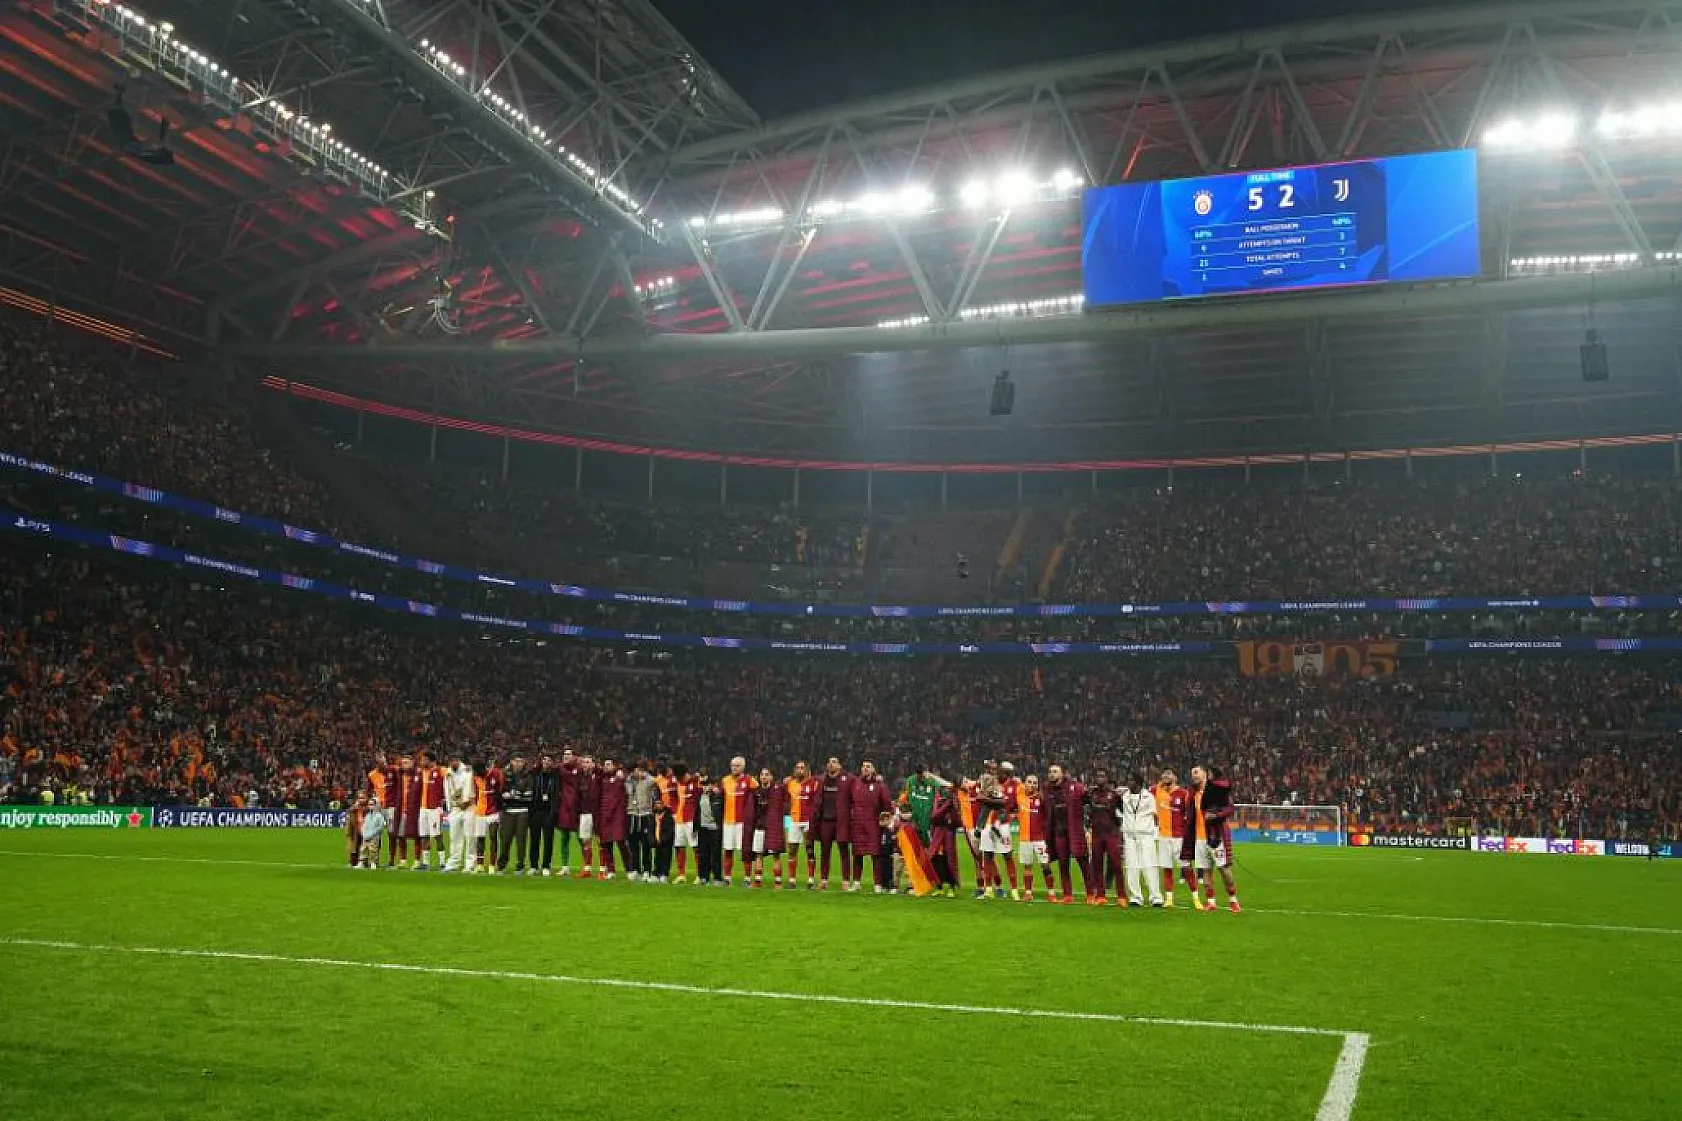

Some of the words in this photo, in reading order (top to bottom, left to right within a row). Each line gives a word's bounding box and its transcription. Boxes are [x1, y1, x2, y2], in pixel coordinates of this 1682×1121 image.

[1248, 187, 1263, 210] 5
[1279, 184, 1294, 208] 2
[65, 470, 94, 485] LEAGUE
[38, 809, 122, 828] responsibly
[179, 811, 214, 827] UEFA
[217, 811, 288, 828] CHAMPIONS
[291, 813, 333, 828] LEAGUE
[1275, 831, 1317, 843] PS5
[1373, 834, 1466, 849] mastercard
[1477, 836, 1528, 853] FedEx
[1546, 838, 1598, 854] FedEx
